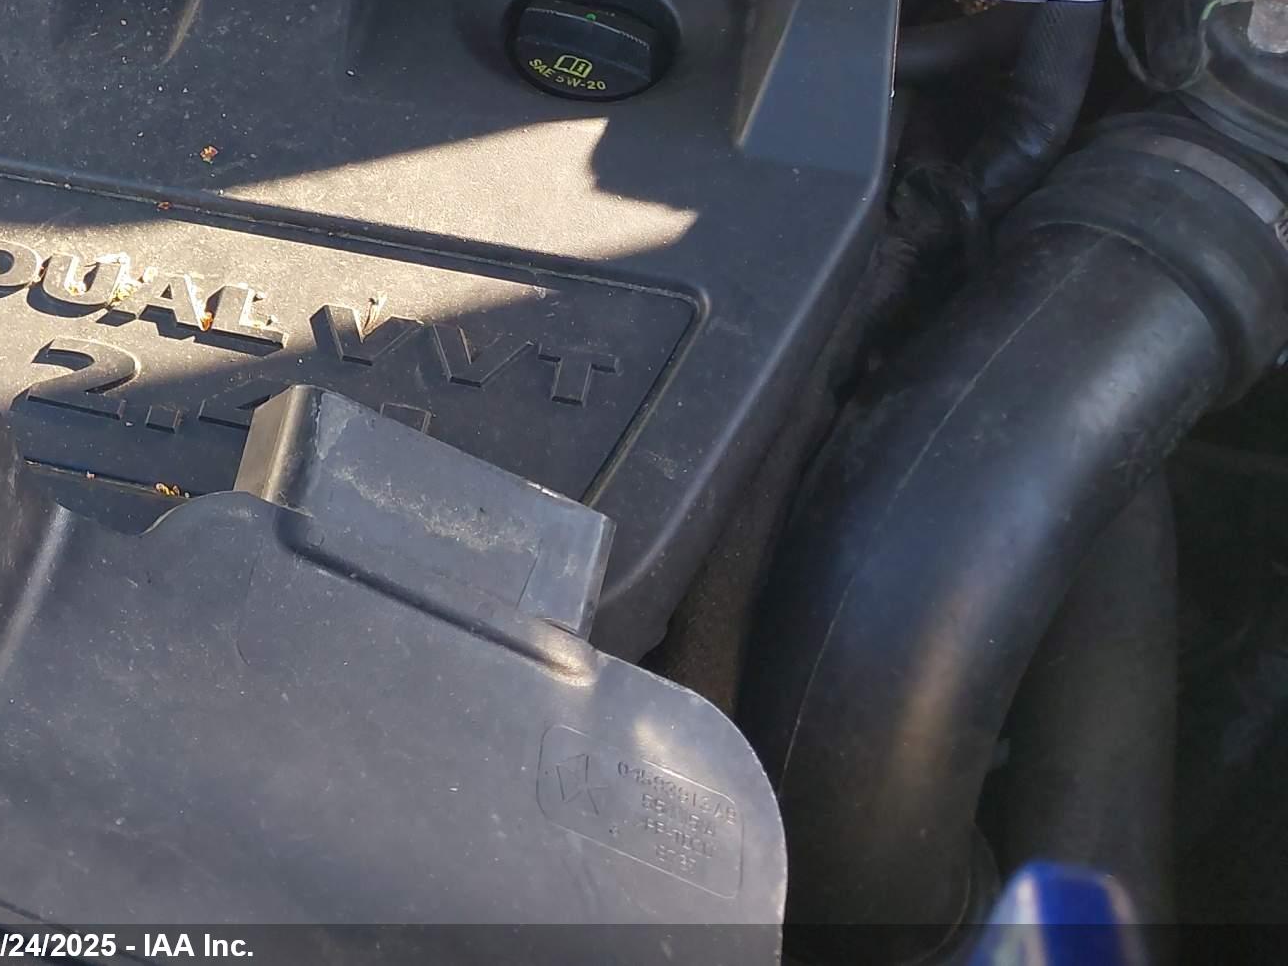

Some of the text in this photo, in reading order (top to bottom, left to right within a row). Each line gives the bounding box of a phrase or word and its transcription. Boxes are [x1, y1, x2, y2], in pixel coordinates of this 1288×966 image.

[529, 58, 607, 90] SAE 5W-20
[310, 304, 621, 407] VVT
